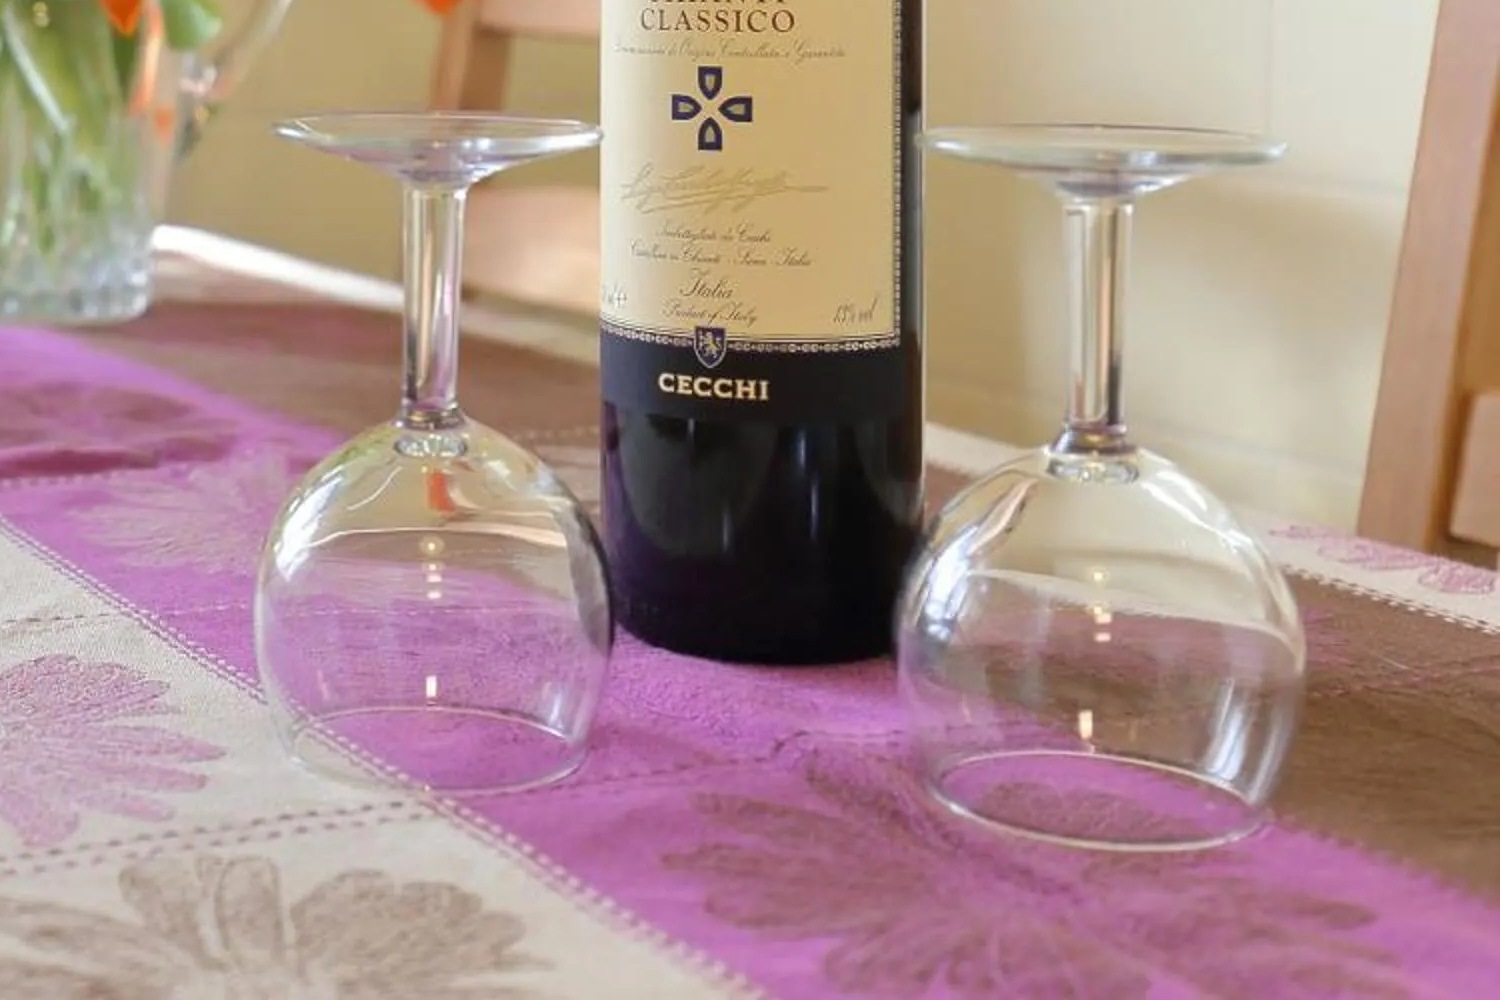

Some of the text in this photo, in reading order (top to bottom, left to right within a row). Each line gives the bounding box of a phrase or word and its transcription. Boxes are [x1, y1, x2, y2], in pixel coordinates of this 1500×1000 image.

[640, 7, 796, 33] CLASSICO
[678, 268, 734, 299] Italia
[657, 372, 771, 401] CECCHI
